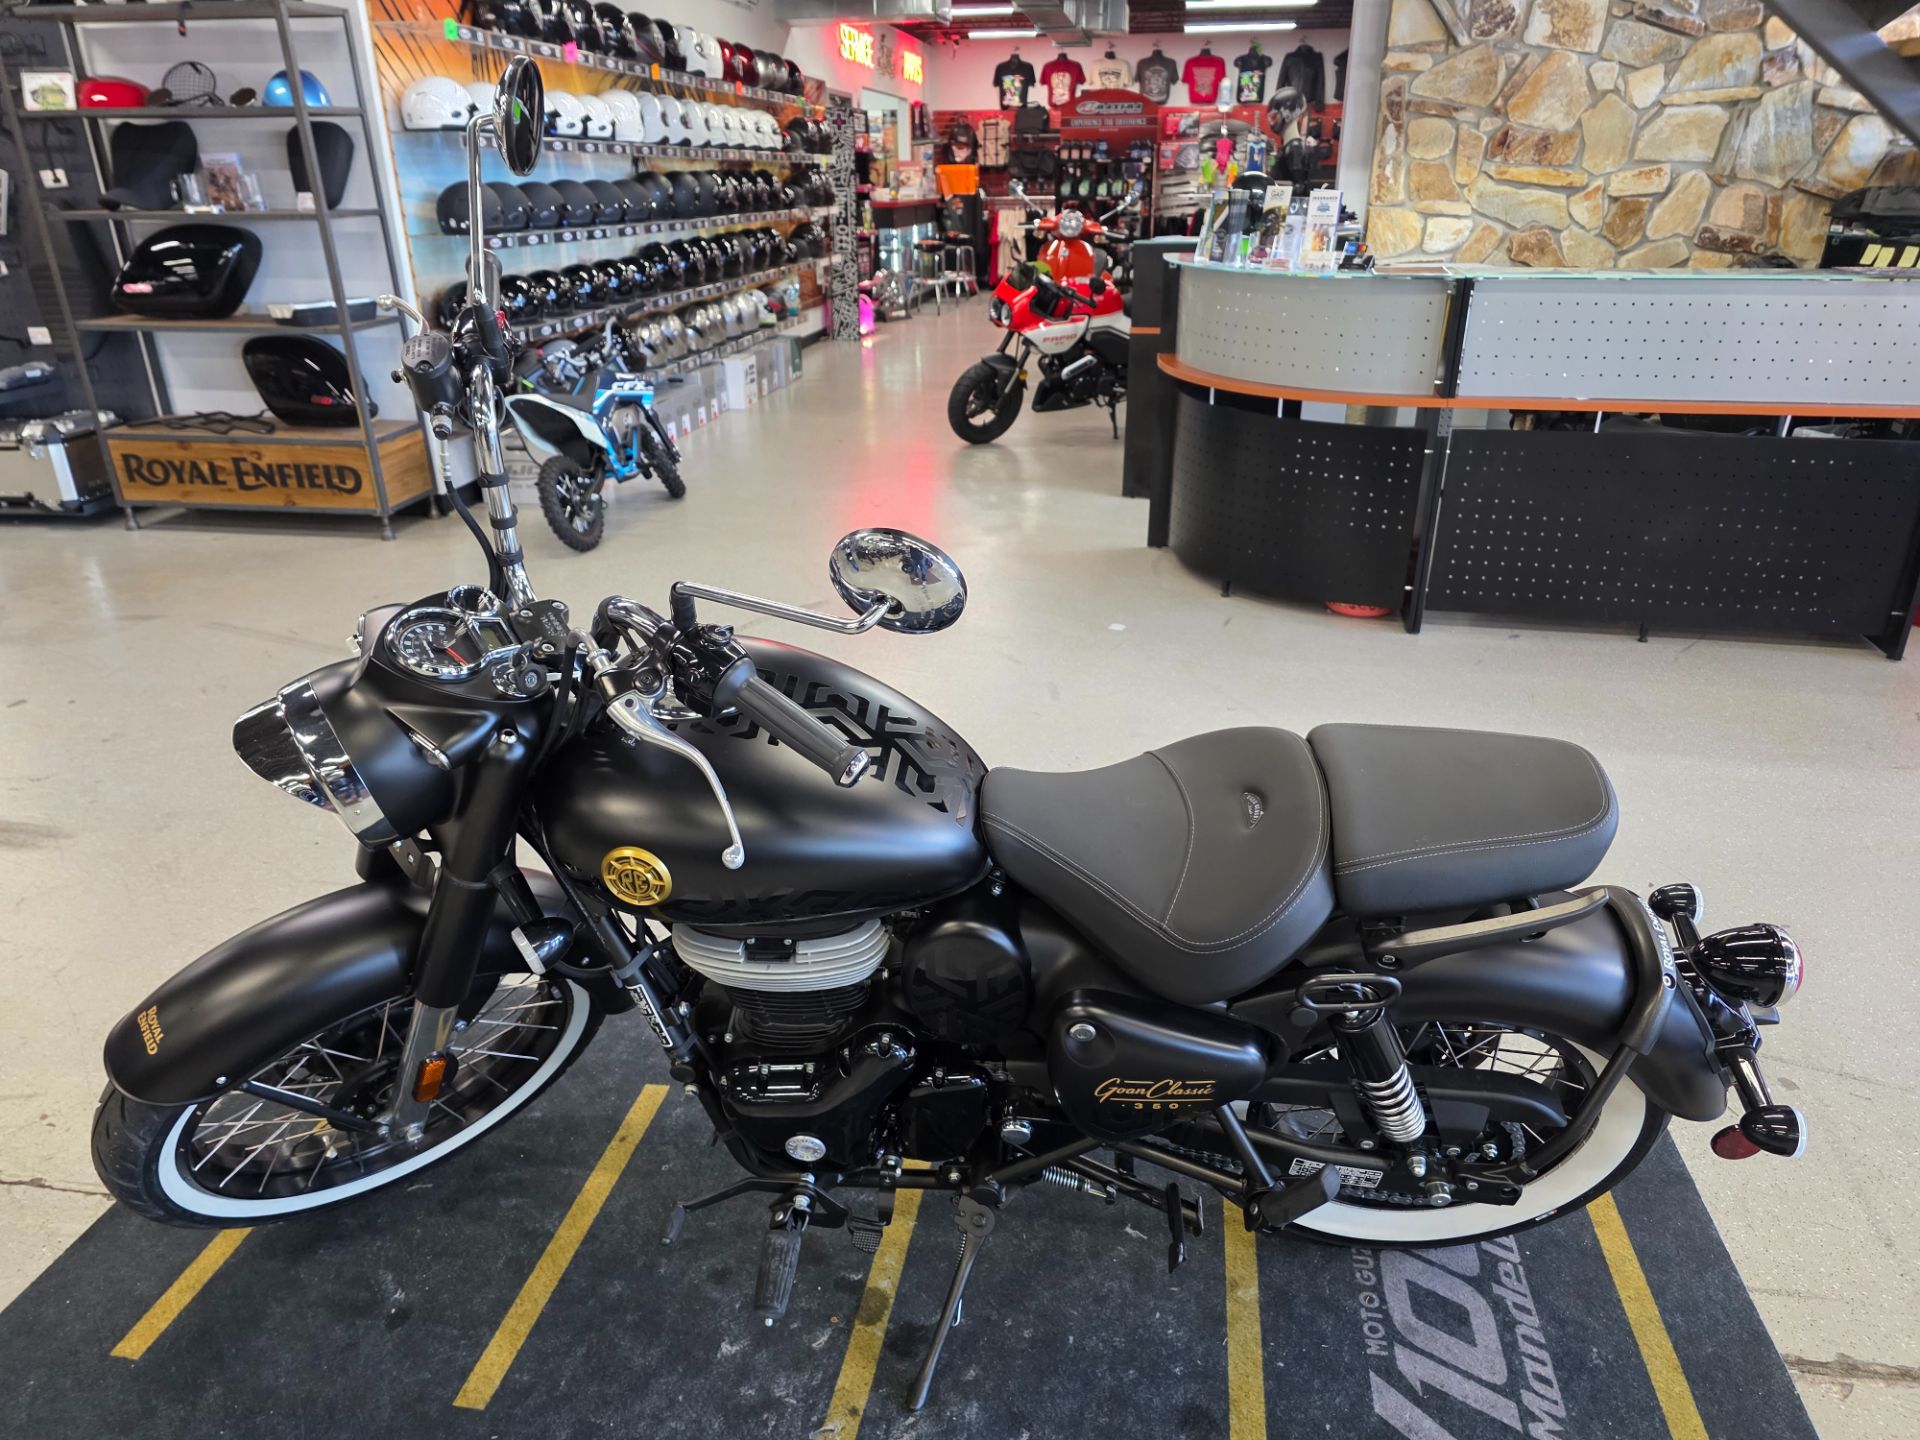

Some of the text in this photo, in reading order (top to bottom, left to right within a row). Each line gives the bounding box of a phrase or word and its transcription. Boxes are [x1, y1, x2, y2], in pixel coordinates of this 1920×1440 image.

[121, 453, 362, 494] ROYAL ENFIELD
[1660, 934, 1674, 970] ROYAL
[137, 1010, 158, 1055] ENFIELD
[147, 1005, 164, 1044] ROYAL
[1094, 1077, 1216, 1103] Goan Classic
[1359, 1291, 1388, 1356] MOTO
